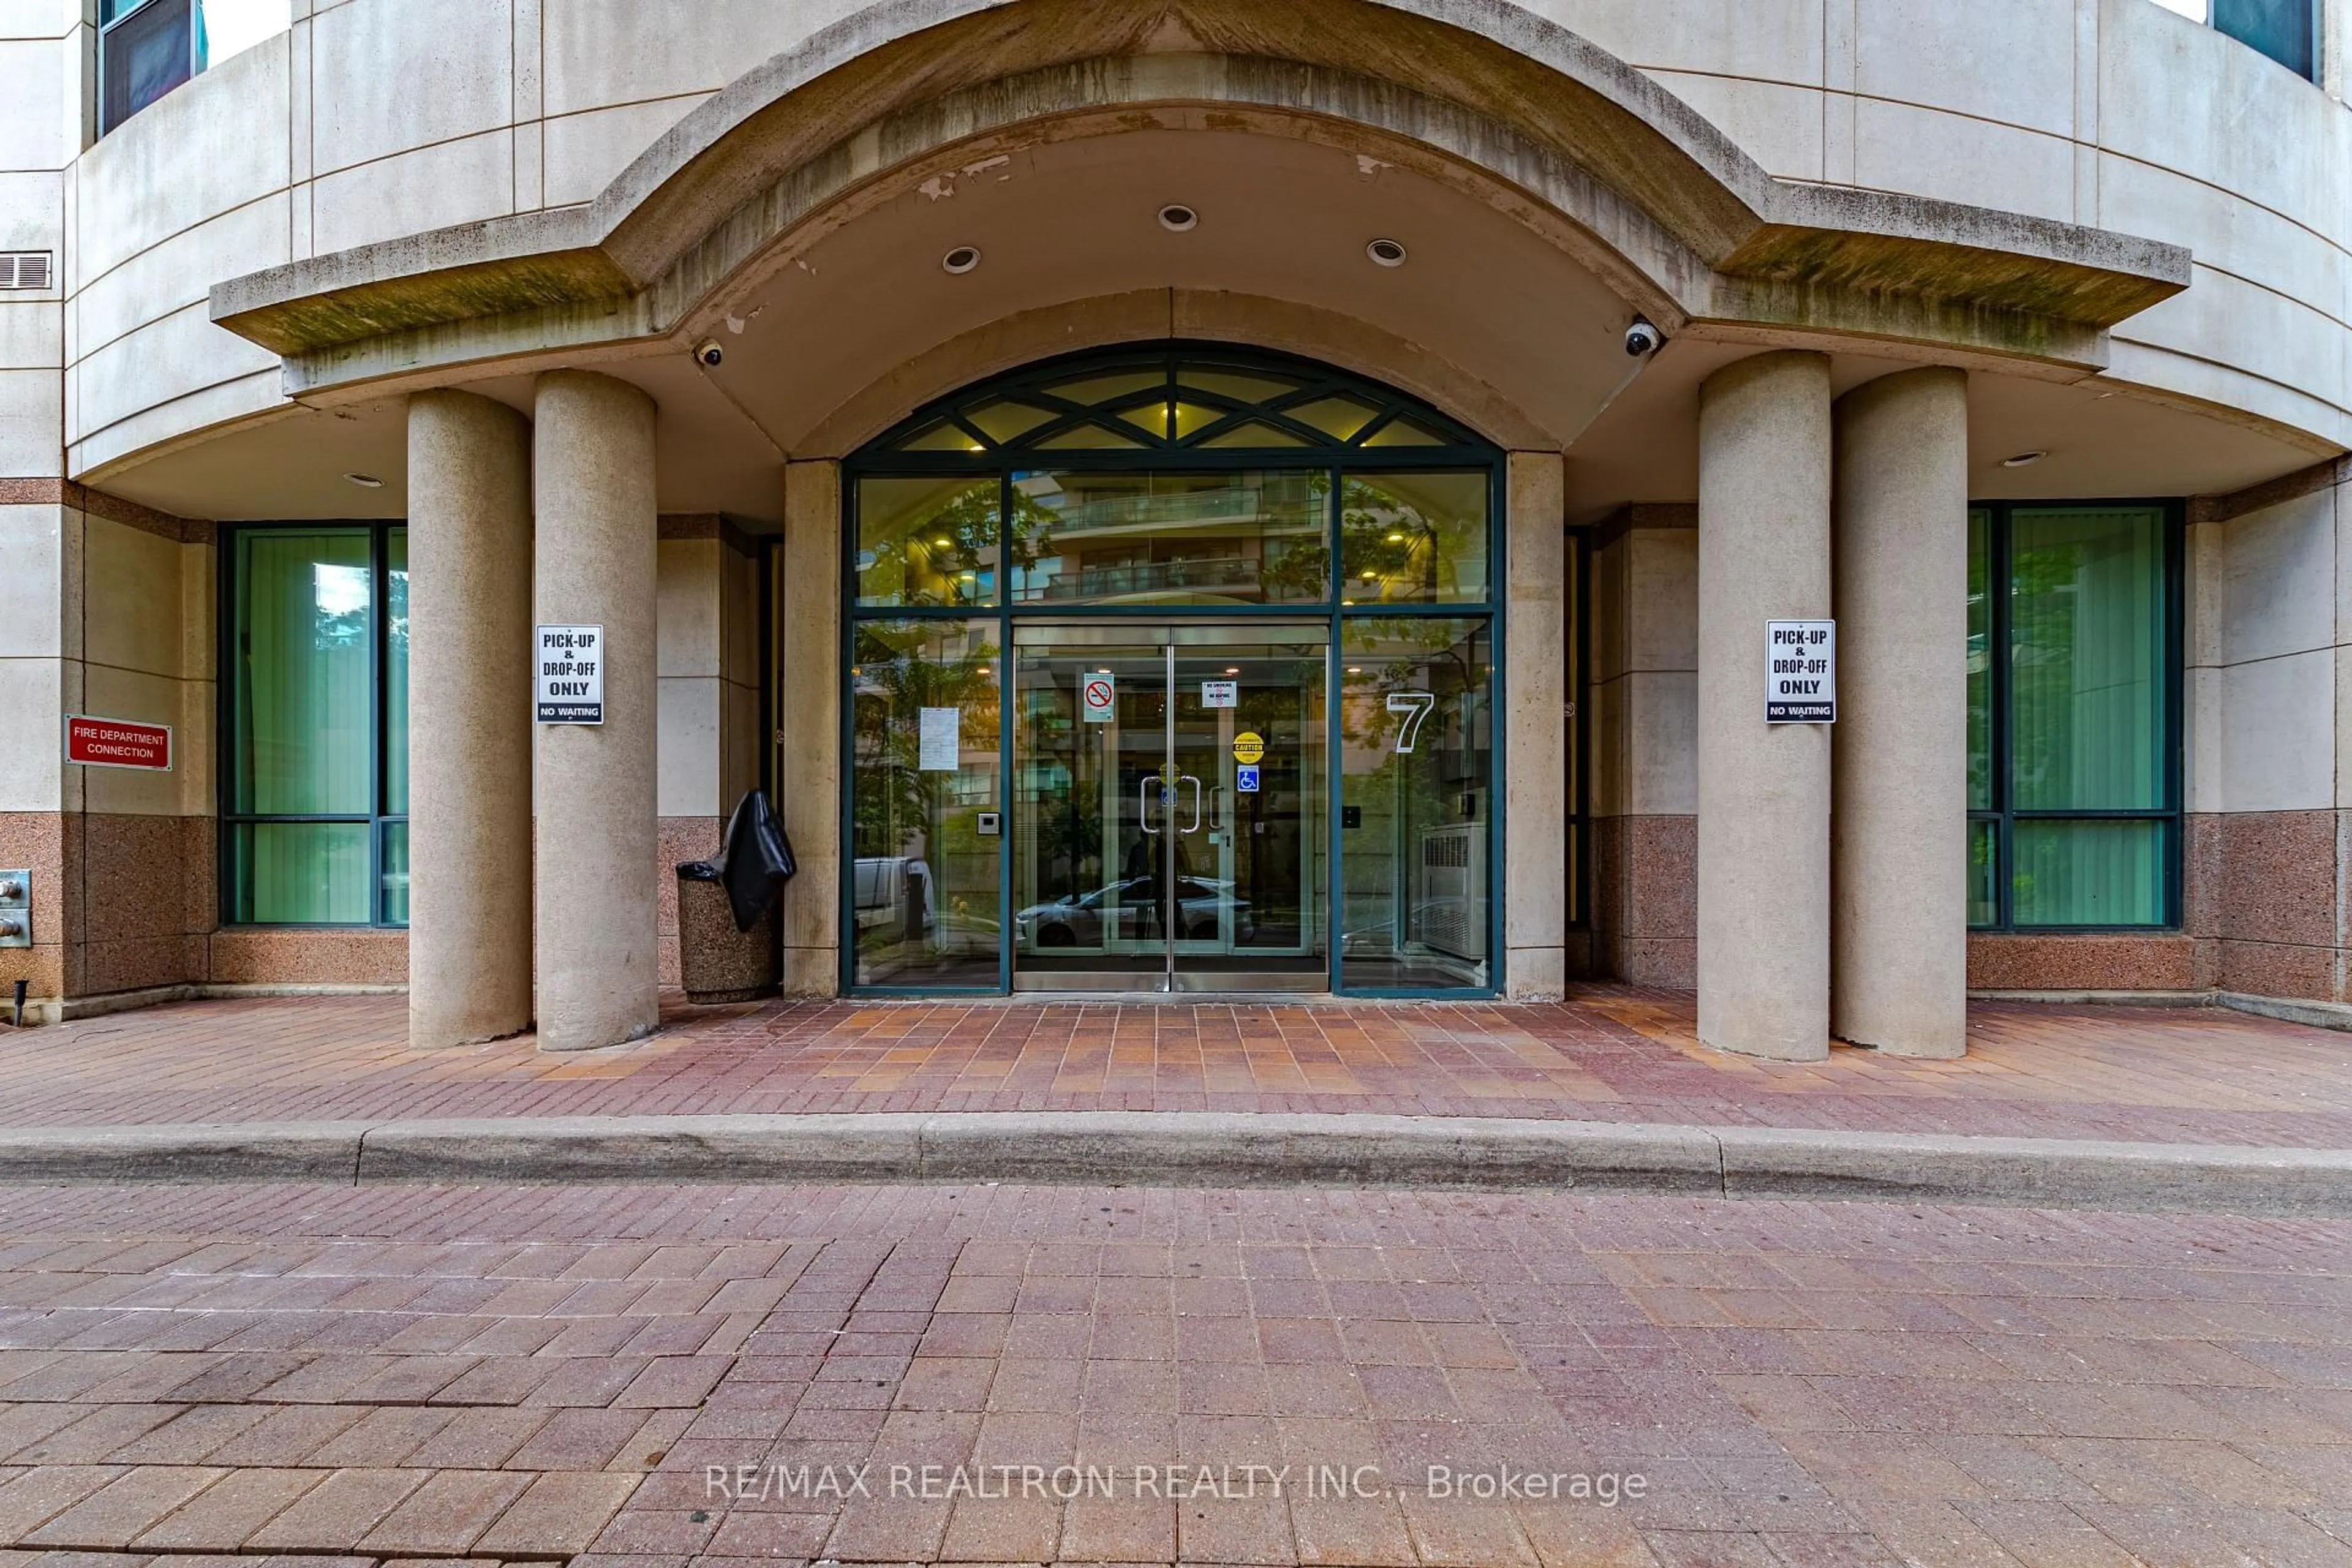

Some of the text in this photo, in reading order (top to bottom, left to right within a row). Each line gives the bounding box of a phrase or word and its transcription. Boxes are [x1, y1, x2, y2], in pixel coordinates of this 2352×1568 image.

[543, 634, 595, 648] PICK-UP
[1774, 630, 1827, 644] PICK-UP
[564, 650, 575, 659] &
[1795, 647, 1806, 657] &
[543, 662, 596, 676] DROP-OFF
[1773, 659, 1828, 674] DROP-OFF
[549, 682, 590, 696] ONLY
[1779, 680, 1821, 694] ONLY
[540, 707, 599, 716] NO WAITING
[1770, 706, 1831, 715] NO WAITING
[1386, 693, 1434, 753] 7
[74, 726, 164, 745] FIRE DEPARTMENT
[87, 743, 153, 758] CONNECTION
